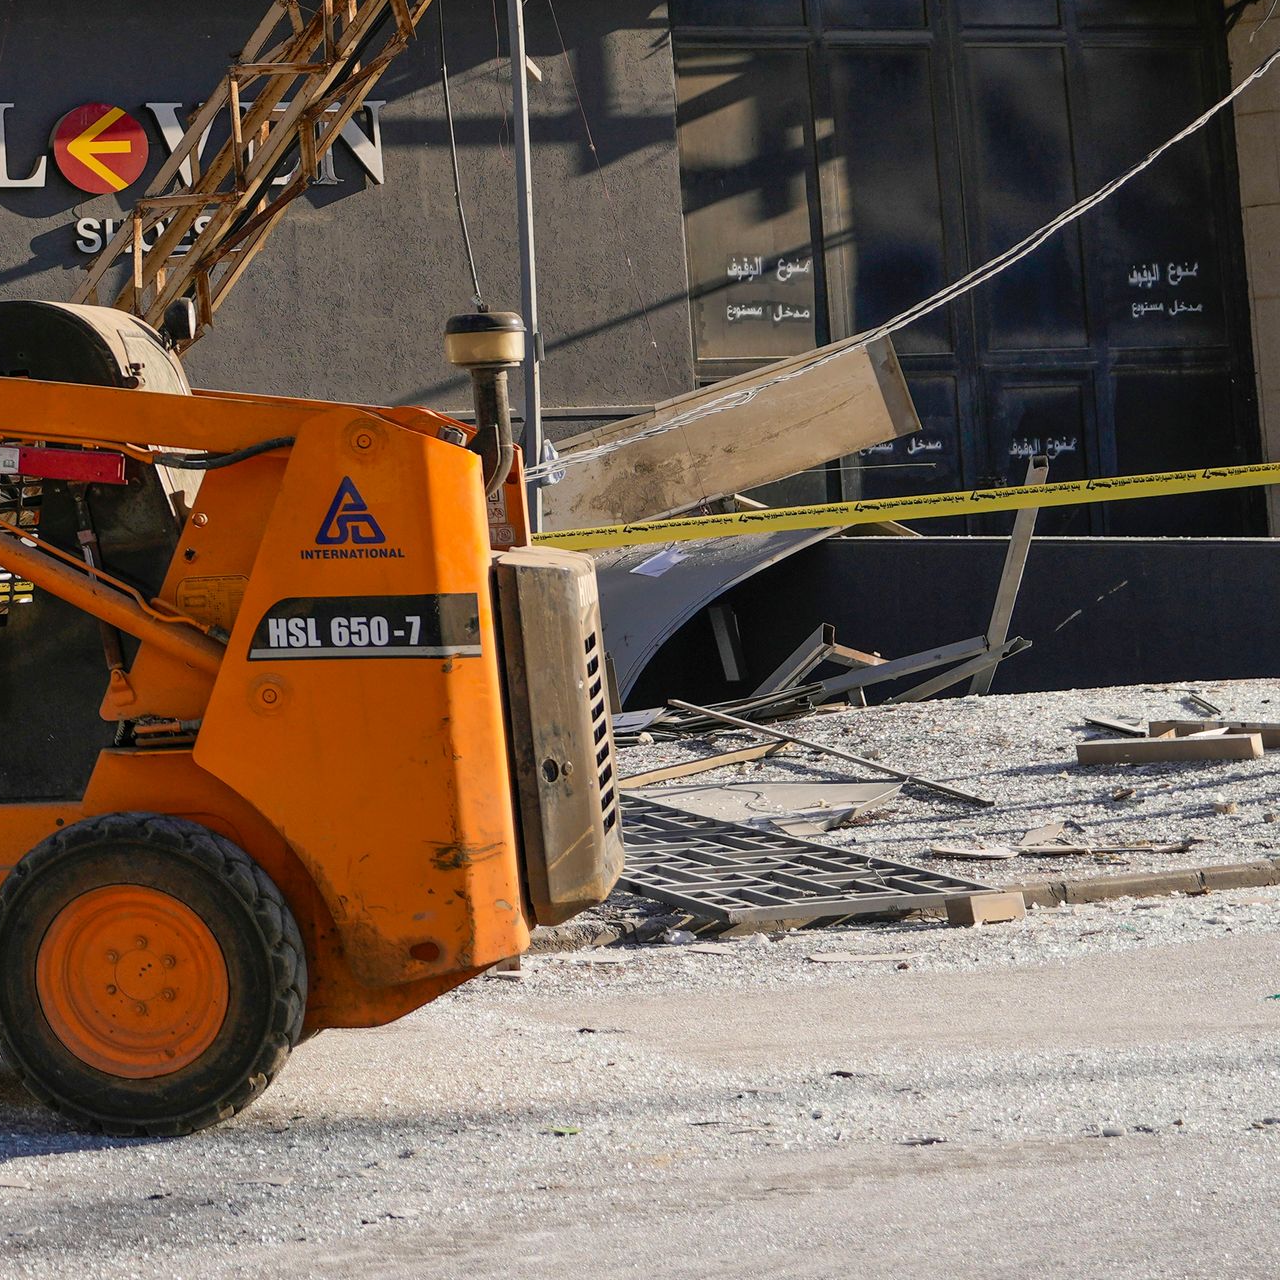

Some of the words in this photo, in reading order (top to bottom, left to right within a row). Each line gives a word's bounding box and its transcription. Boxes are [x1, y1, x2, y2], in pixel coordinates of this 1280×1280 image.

[727, 256, 762, 281] الوقوف
[727, 304, 763, 320] مستودع
[773, 304, 810, 321] مدخل
[1131, 302, 1164, 318] مستودع
[1169, 300, 1203, 316] مدخل
[907, 437, 942, 455] مدخل
[300, 548, 405, 560] INTERNATIONAL
[268, 617, 322, 647] HSL
